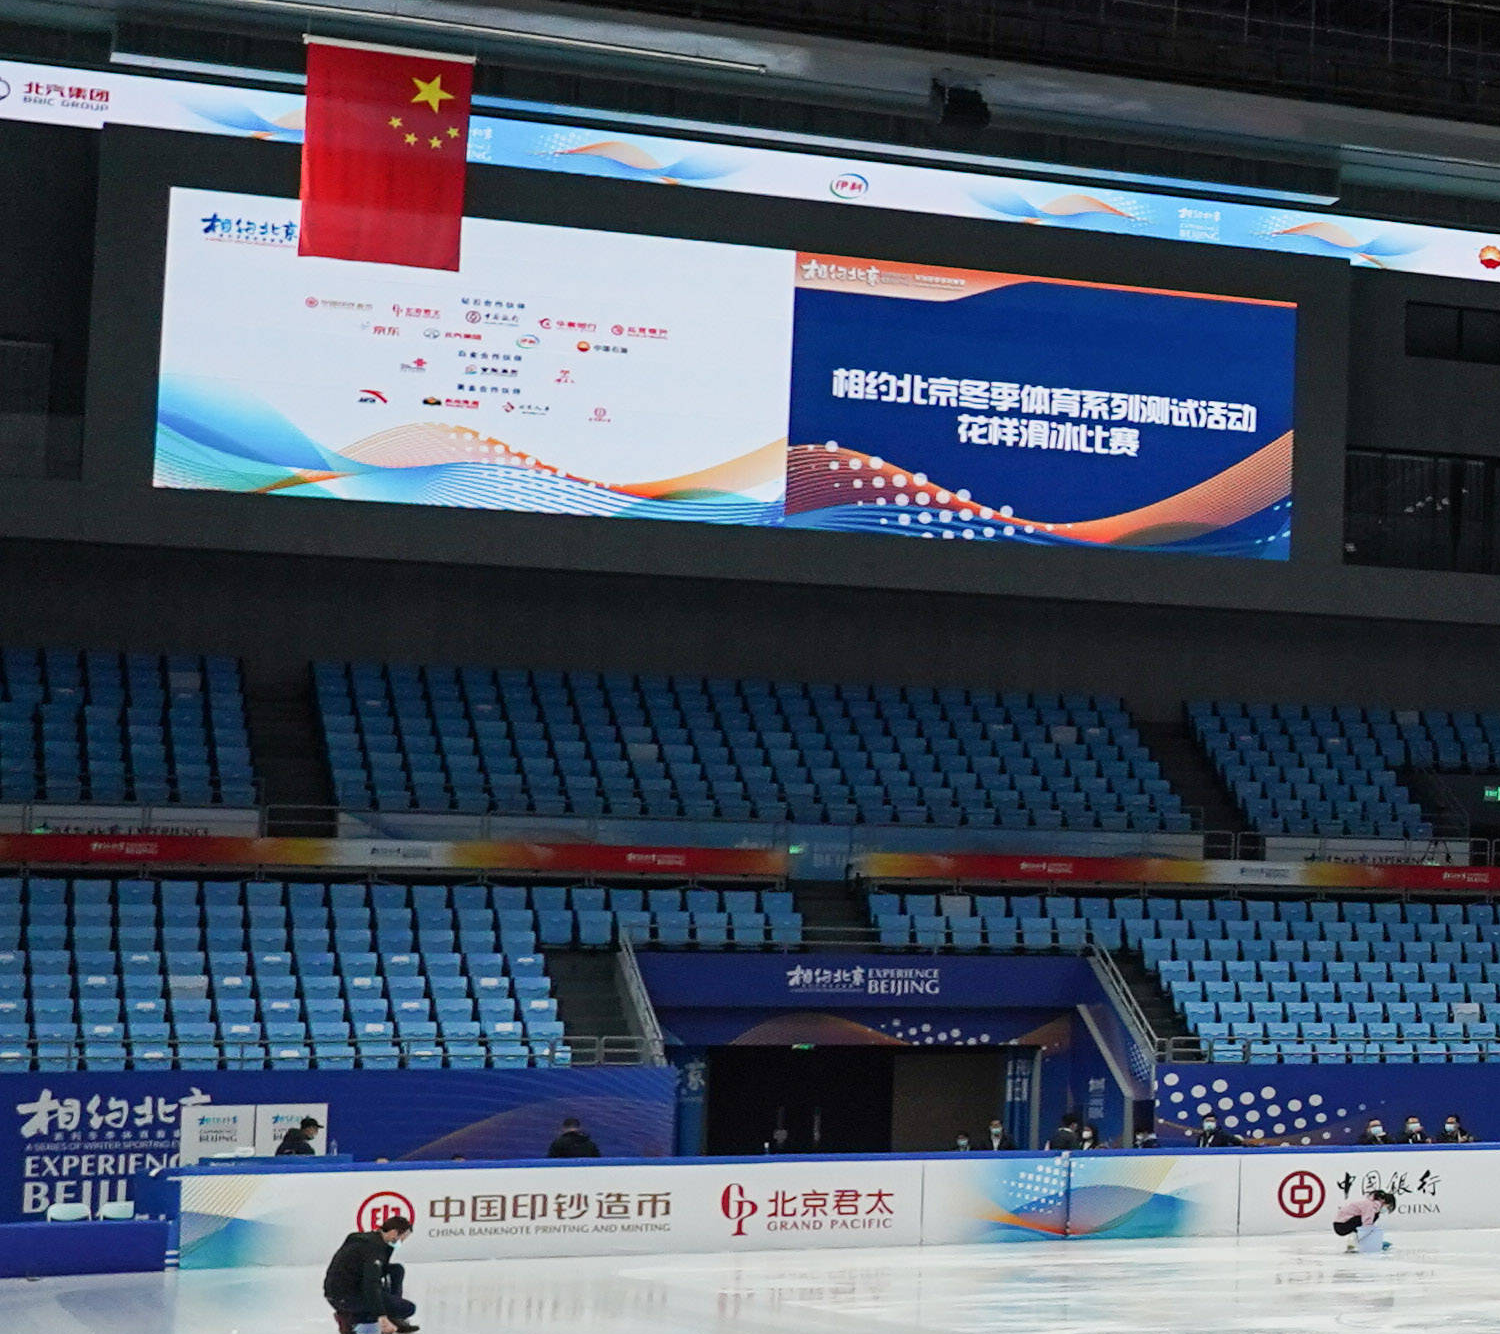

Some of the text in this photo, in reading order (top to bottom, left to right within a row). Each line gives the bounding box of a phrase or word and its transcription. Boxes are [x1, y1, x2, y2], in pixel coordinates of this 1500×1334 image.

[24, 81, 110, 102] 北汽集团
[833, 368, 1257, 433] 相约北京冬季体育系列测试活动
[957, 414, 1141, 458] 花样滑冰比赛
[786, 964, 865, 987] 相约北京
[868, 968, 940, 979] EXPERIENCE
[867, 979, 940, 997] BEIJING
[25, 1153, 181, 1177] EXPERIENC
[1337, 1170, 1441, 1199] 中国银行
[429, 1192, 672, 1223] 中国印钞造币
[767, 1188, 895, 1218] 北京君太
[1398, 1203, 1441, 1215] CHINA
[428, 1222, 672, 1238] CHINA BANKNOTE PRINTING AND MINTING
[767, 1218, 893, 1231] GRAND PACIFIC
